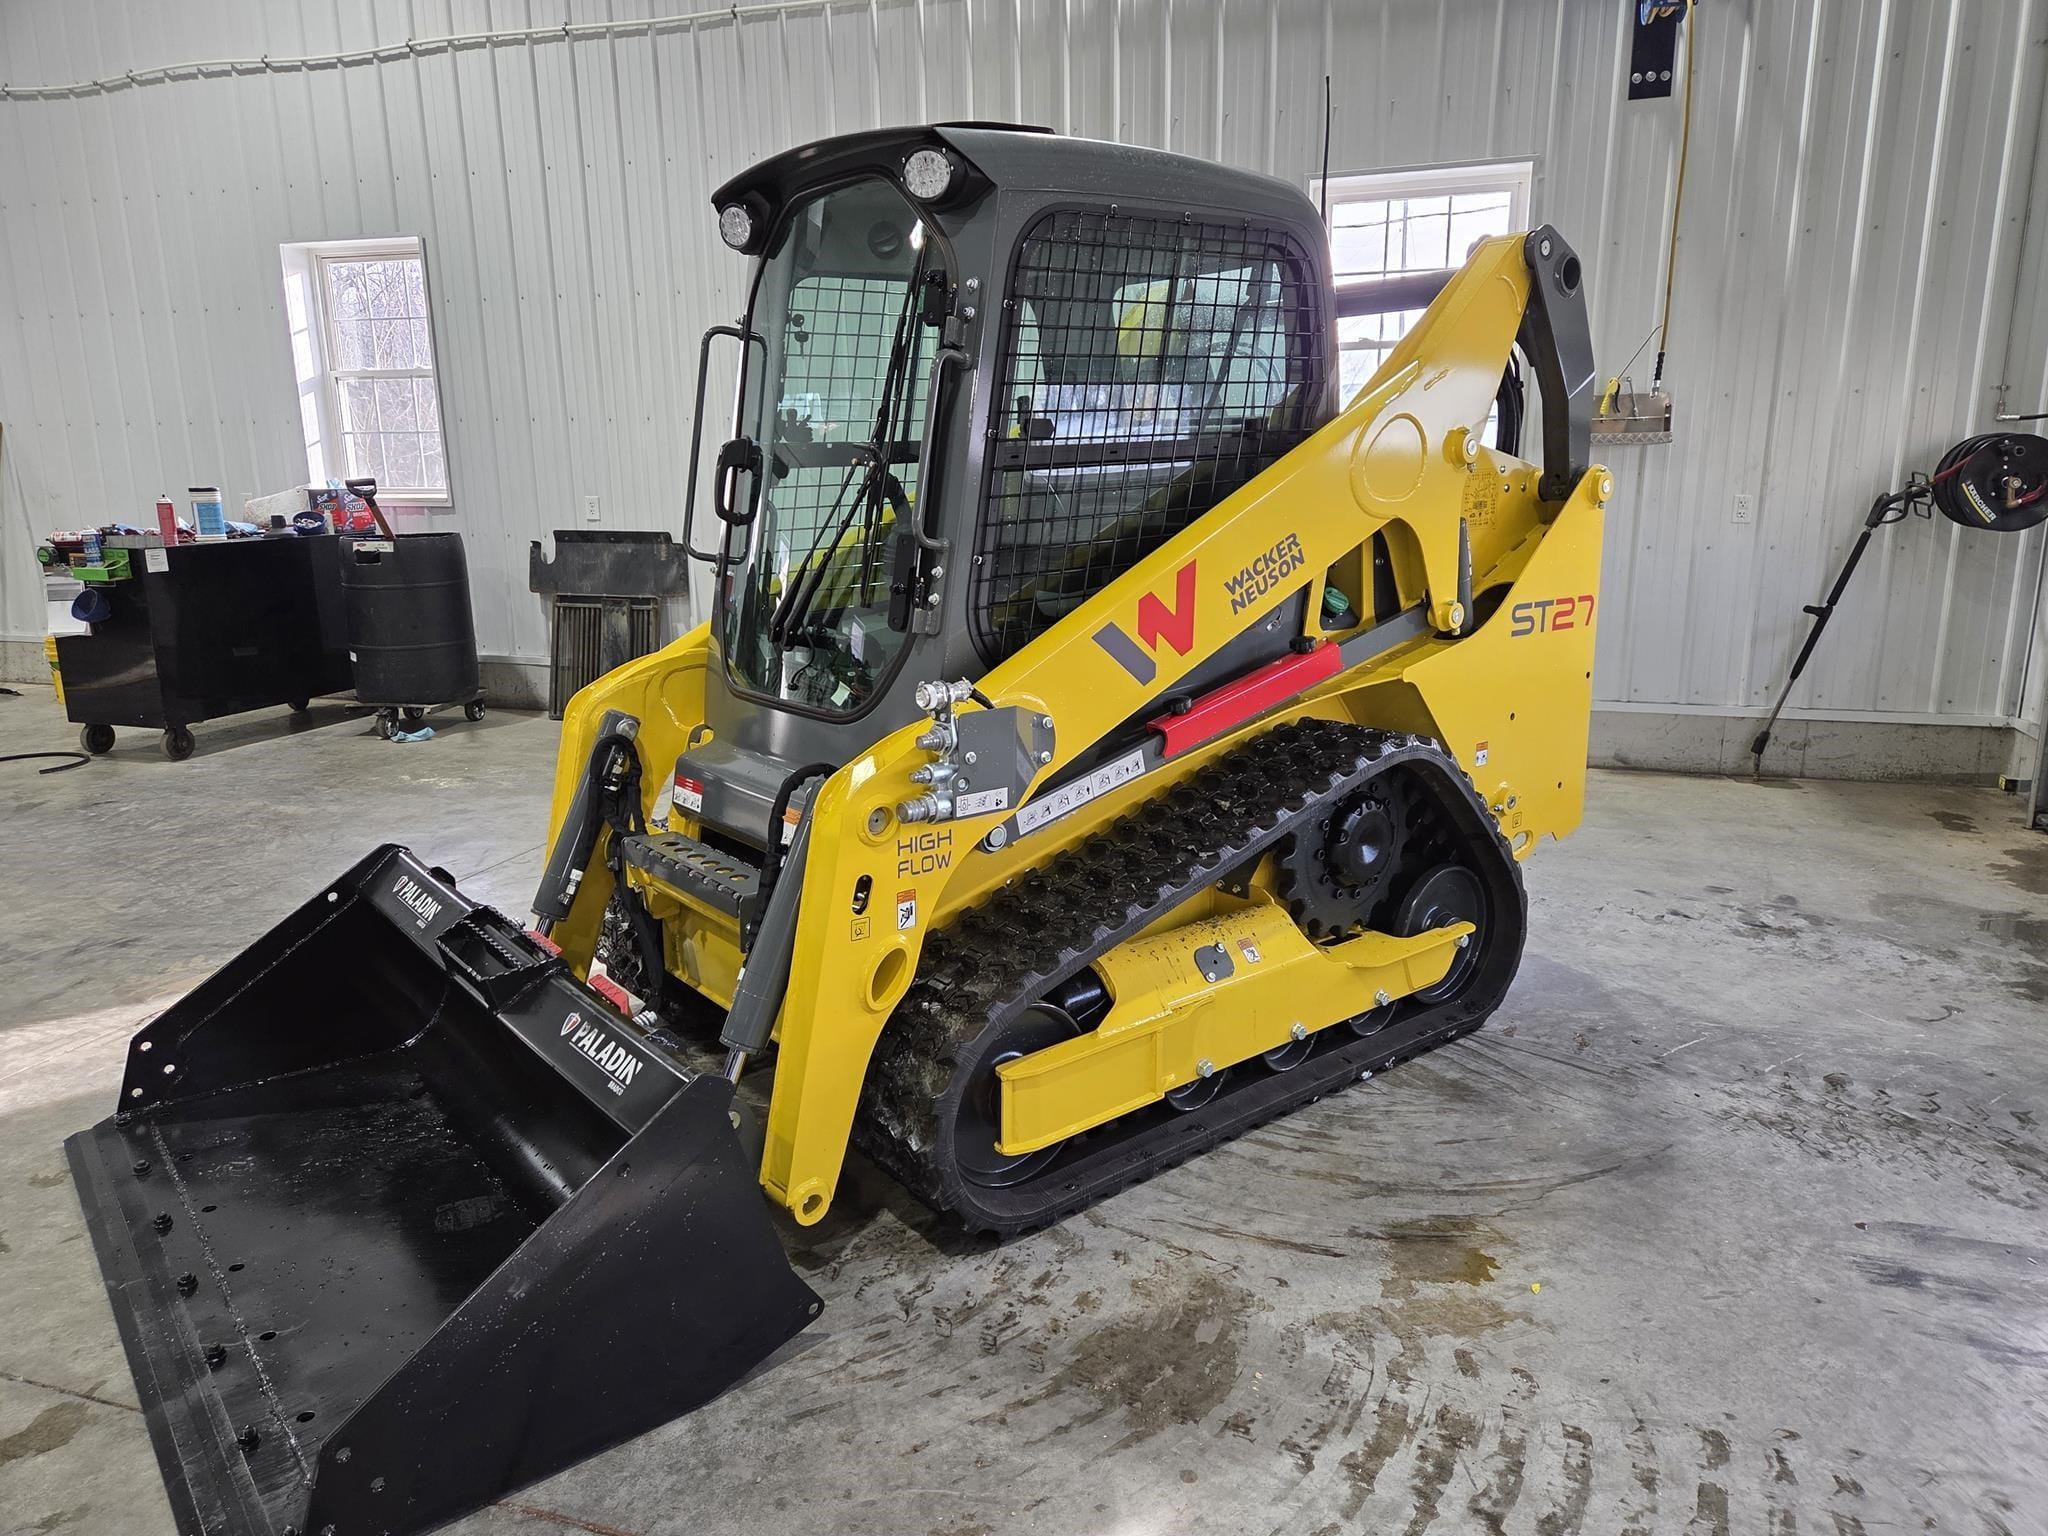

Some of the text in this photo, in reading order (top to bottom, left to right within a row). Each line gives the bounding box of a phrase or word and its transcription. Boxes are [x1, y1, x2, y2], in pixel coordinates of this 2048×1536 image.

[1223, 532, 1301, 595] WACKER
[1231, 547, 1305, 616] NEUSON
[1511, 594, 1595, 637] ST27
[897, 828, 952, 857] HIGH
[897, 849, 952, 879] FLOW
[398, 880, 443, 922] PALADIN
[570, 1020, 644, 1086] PALADIN
